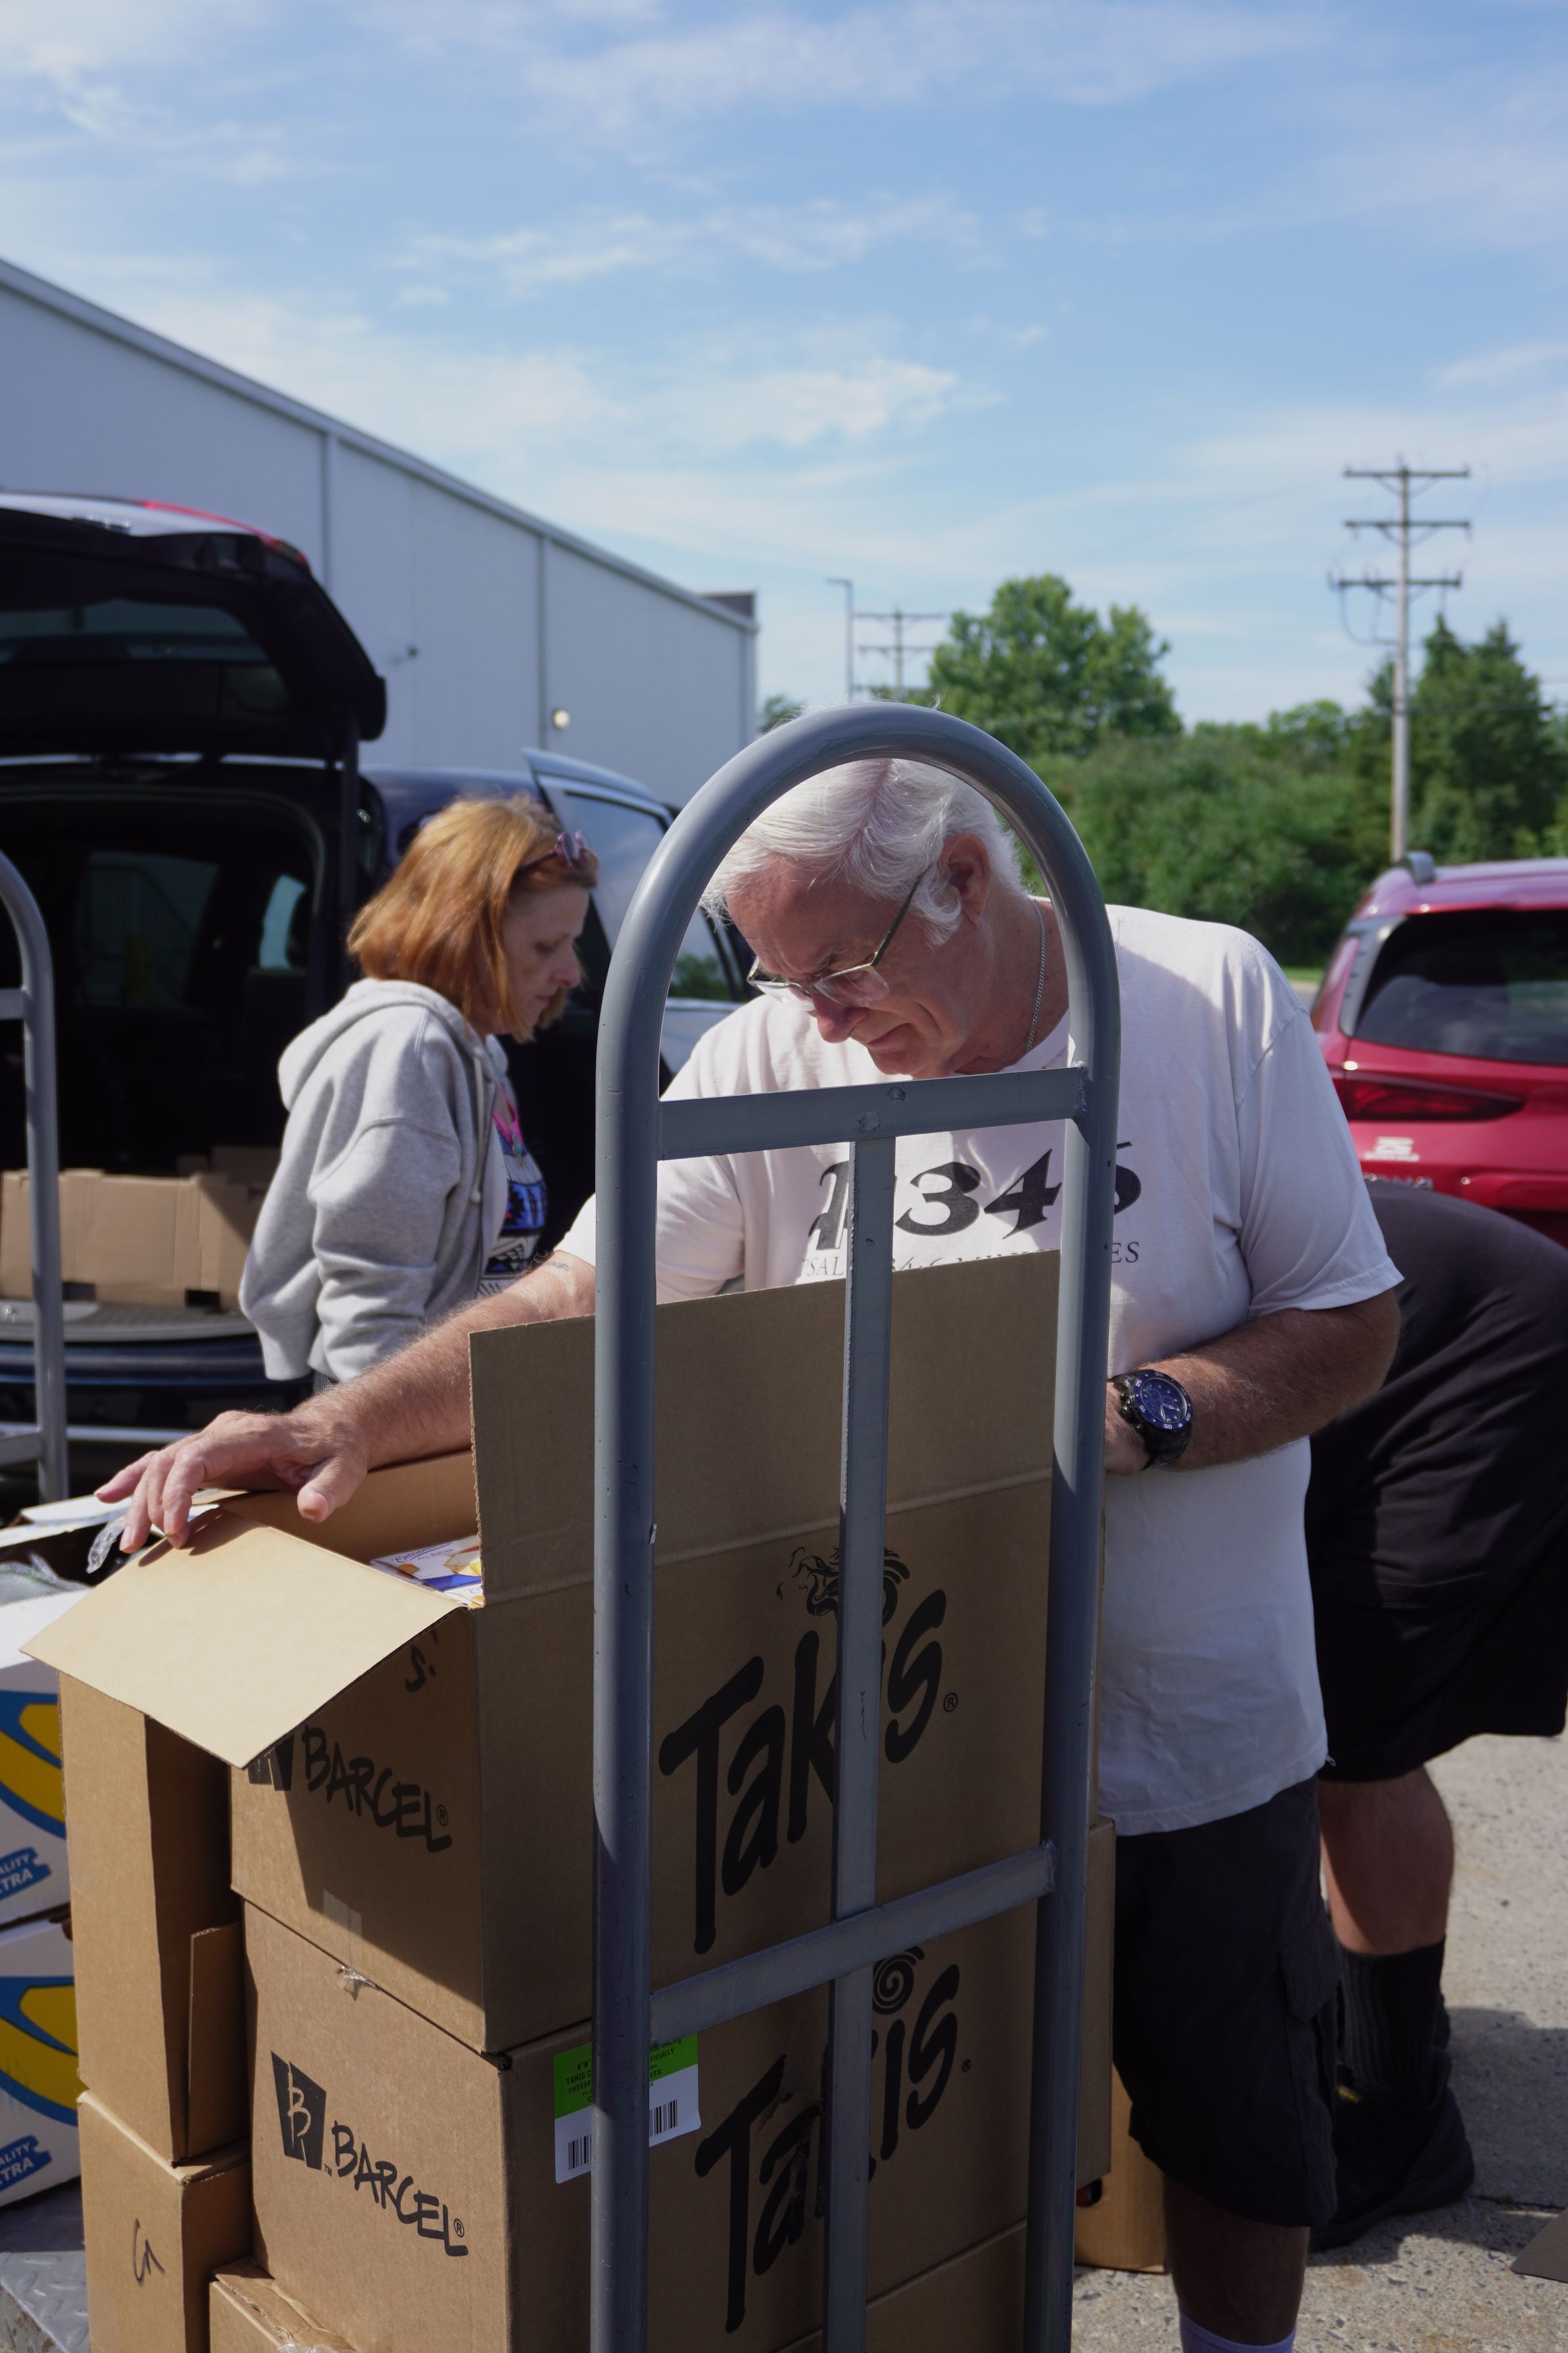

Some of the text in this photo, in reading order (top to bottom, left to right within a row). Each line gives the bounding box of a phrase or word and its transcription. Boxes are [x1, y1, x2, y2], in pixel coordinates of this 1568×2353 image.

[301, 1723, 453, 1853] BARCEL
[659, 1589, 946, 1955] Taks
[566, 2072, 586, 2085] TAKIS
[568, 2080, 591, 2094] CHEESE
[331, 2120, 469, 2257] BARCEL
